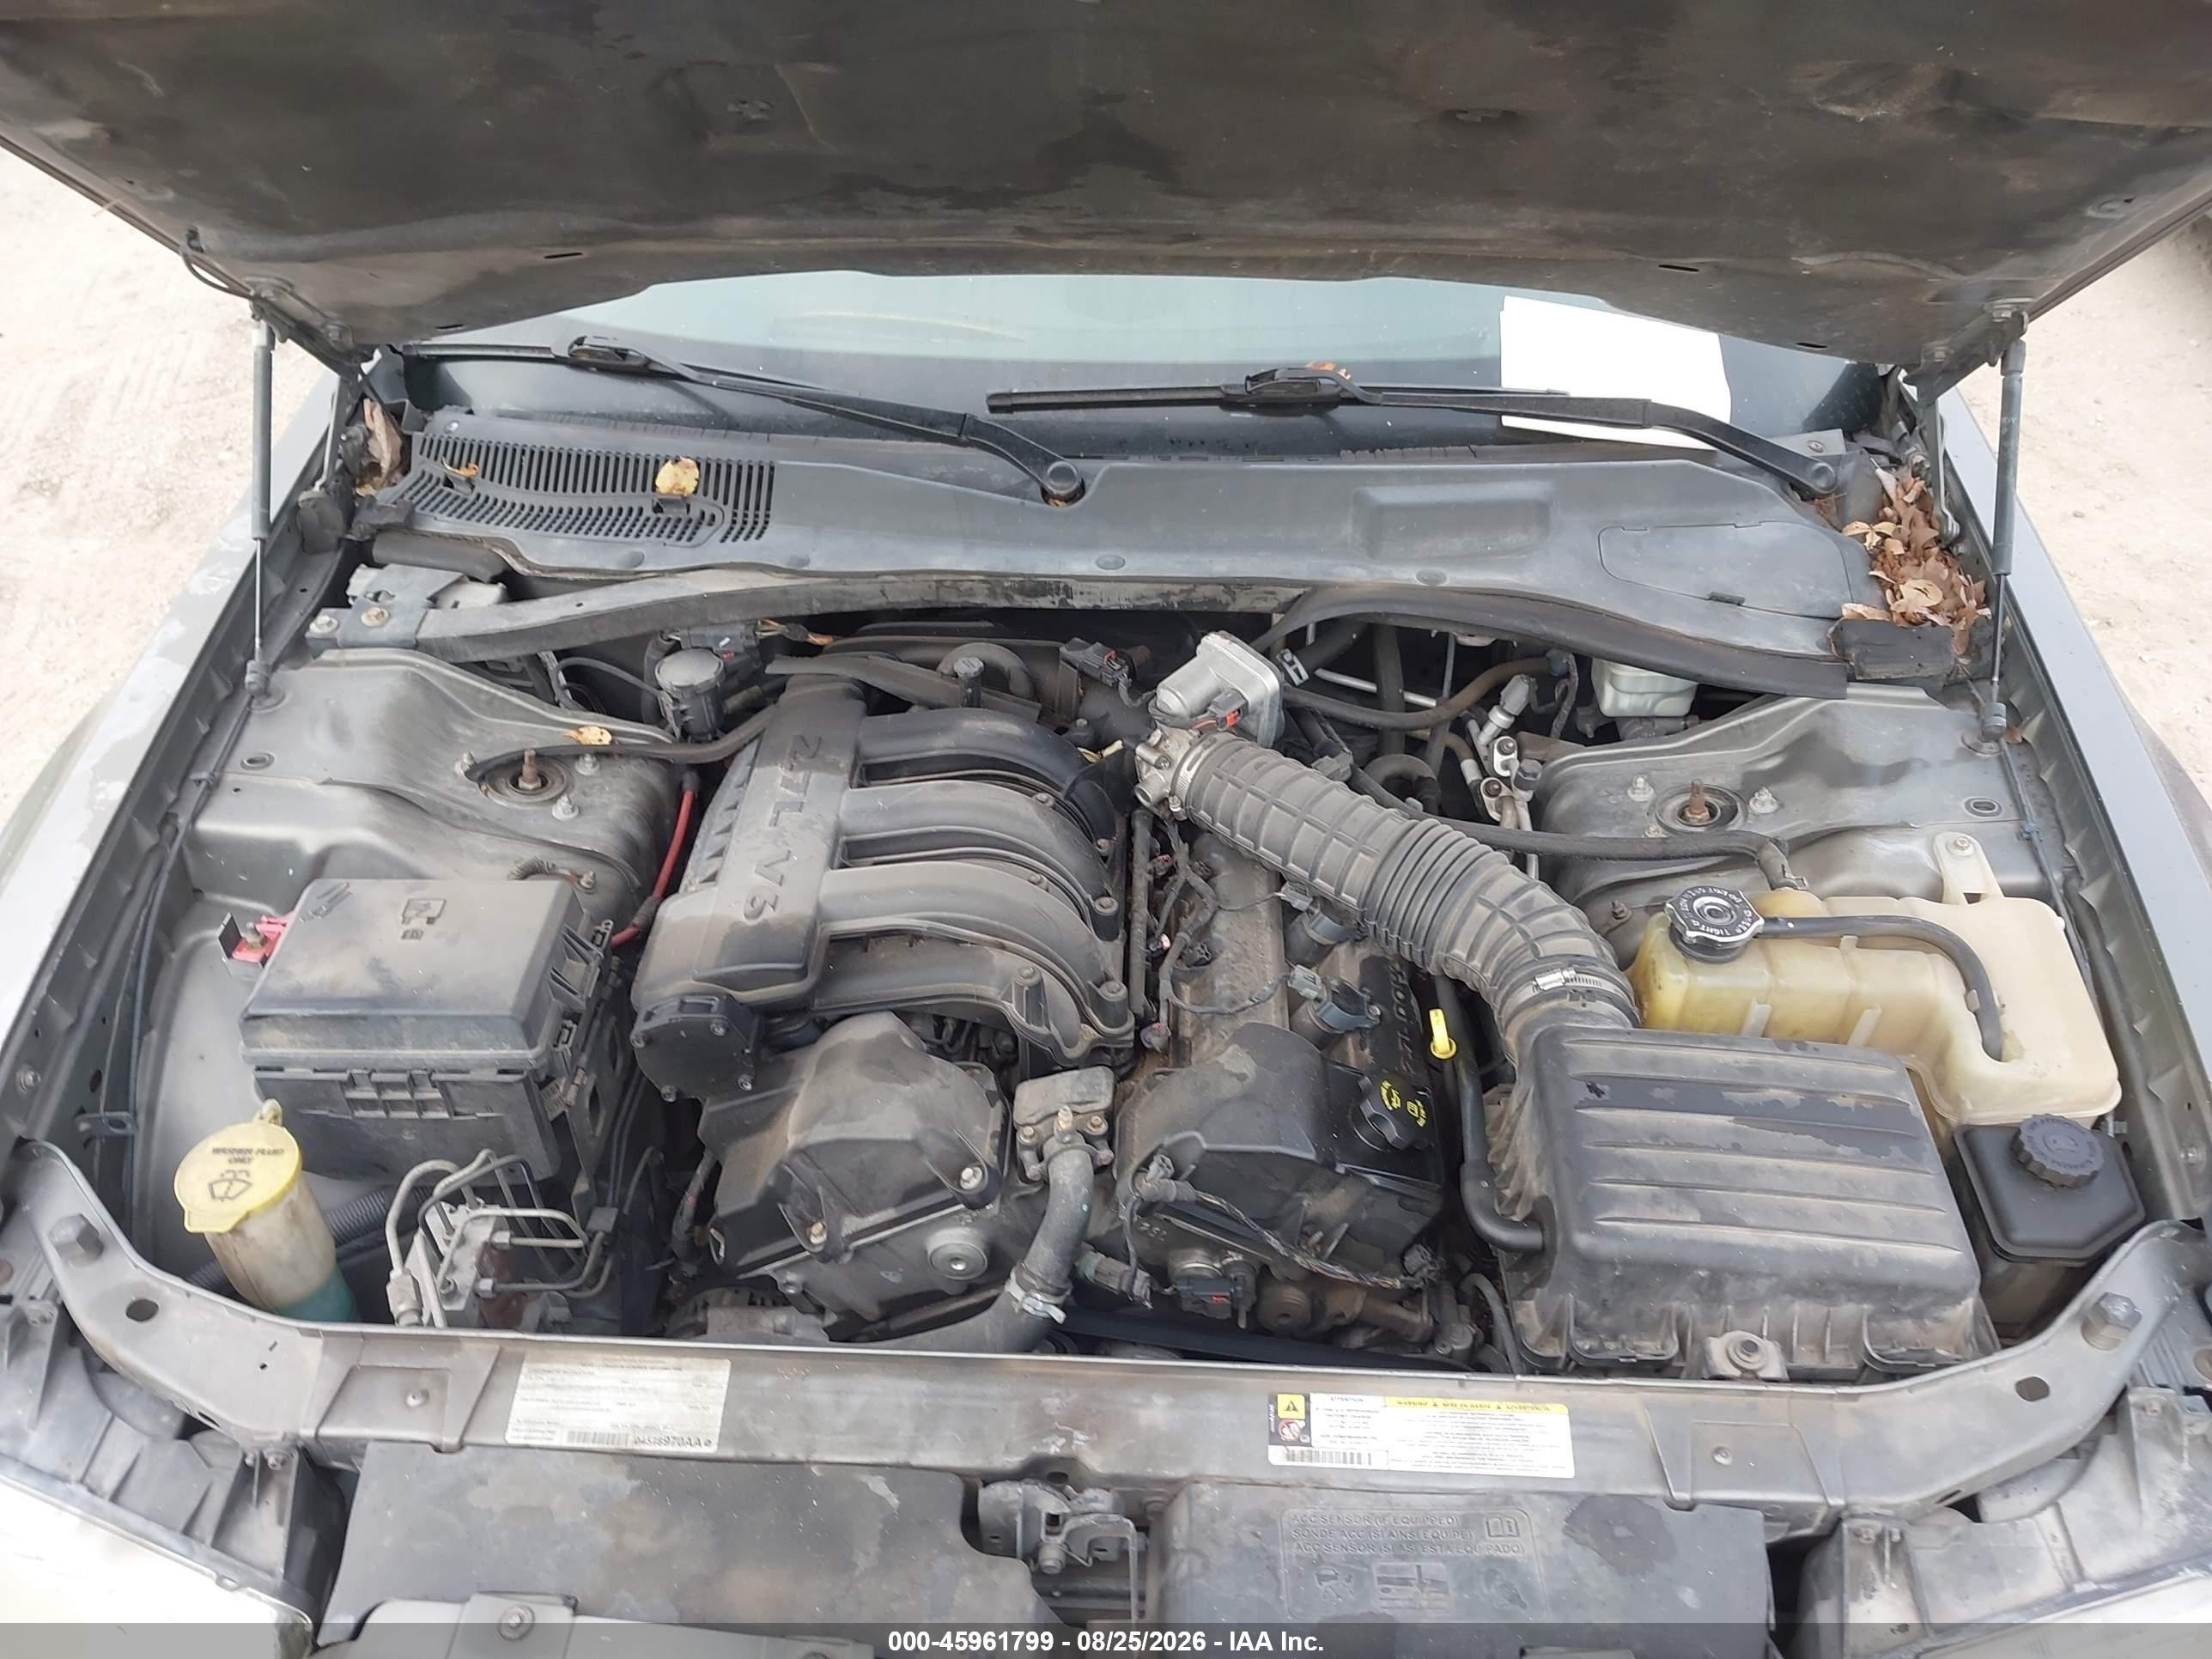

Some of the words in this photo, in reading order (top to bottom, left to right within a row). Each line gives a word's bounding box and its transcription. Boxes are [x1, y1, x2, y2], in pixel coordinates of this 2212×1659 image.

[742, 850, 792, 921] V6
[1291, 1513, 1318, 1526] ACC
[1320, 1514, 1373, 1526] SENSOR
[1291, 1528, 1336, 1540] SONDE
[1340, 1528, 1364, 1540] ACC
[1296, 1542, 1322, 1553] ACC
[1323, 1543, 1376, 1554] SENSOR
[1456, 1544, 1525, 1556] EQUIPADO)
